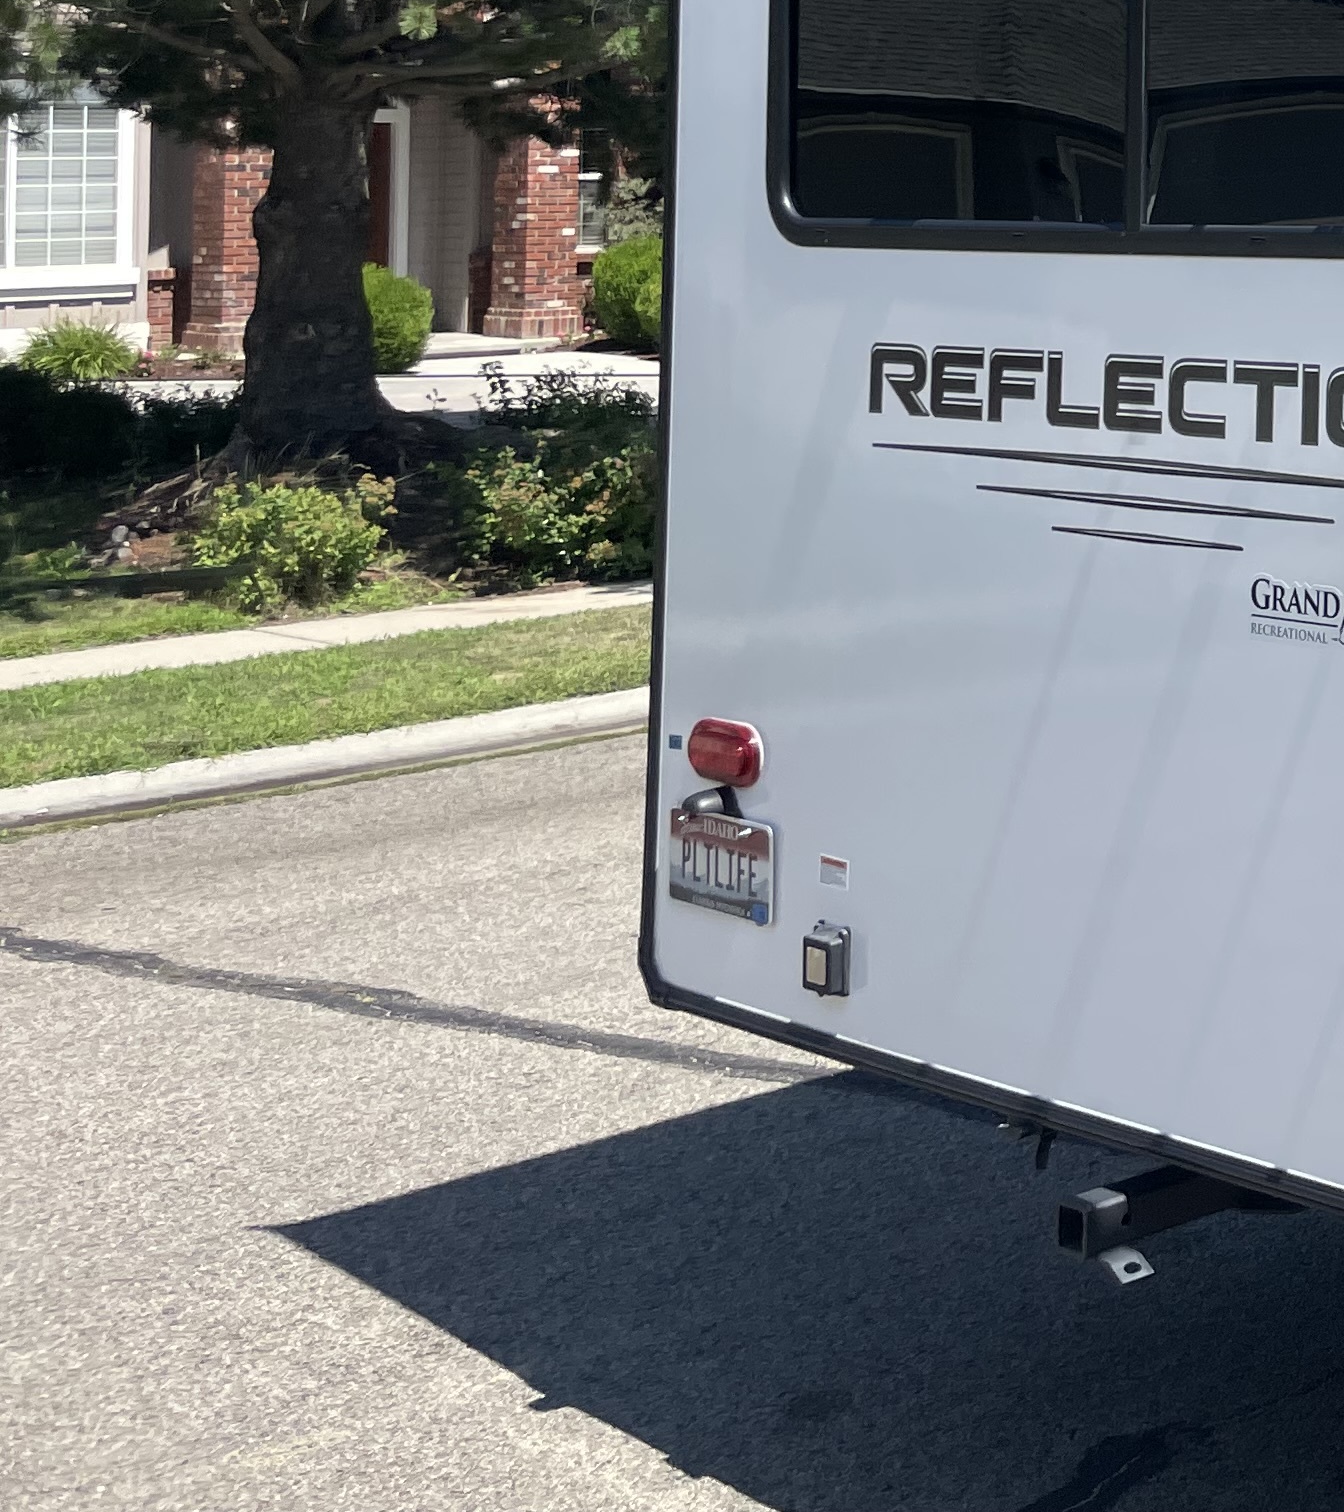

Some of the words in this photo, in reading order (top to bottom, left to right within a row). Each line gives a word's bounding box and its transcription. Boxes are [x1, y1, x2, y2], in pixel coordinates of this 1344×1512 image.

[1251, 578, 1341, 619] GRAND
[1250, 622, 1329, 645] RECREATIONAL
[703, 818, 739, 841] IDAHO
